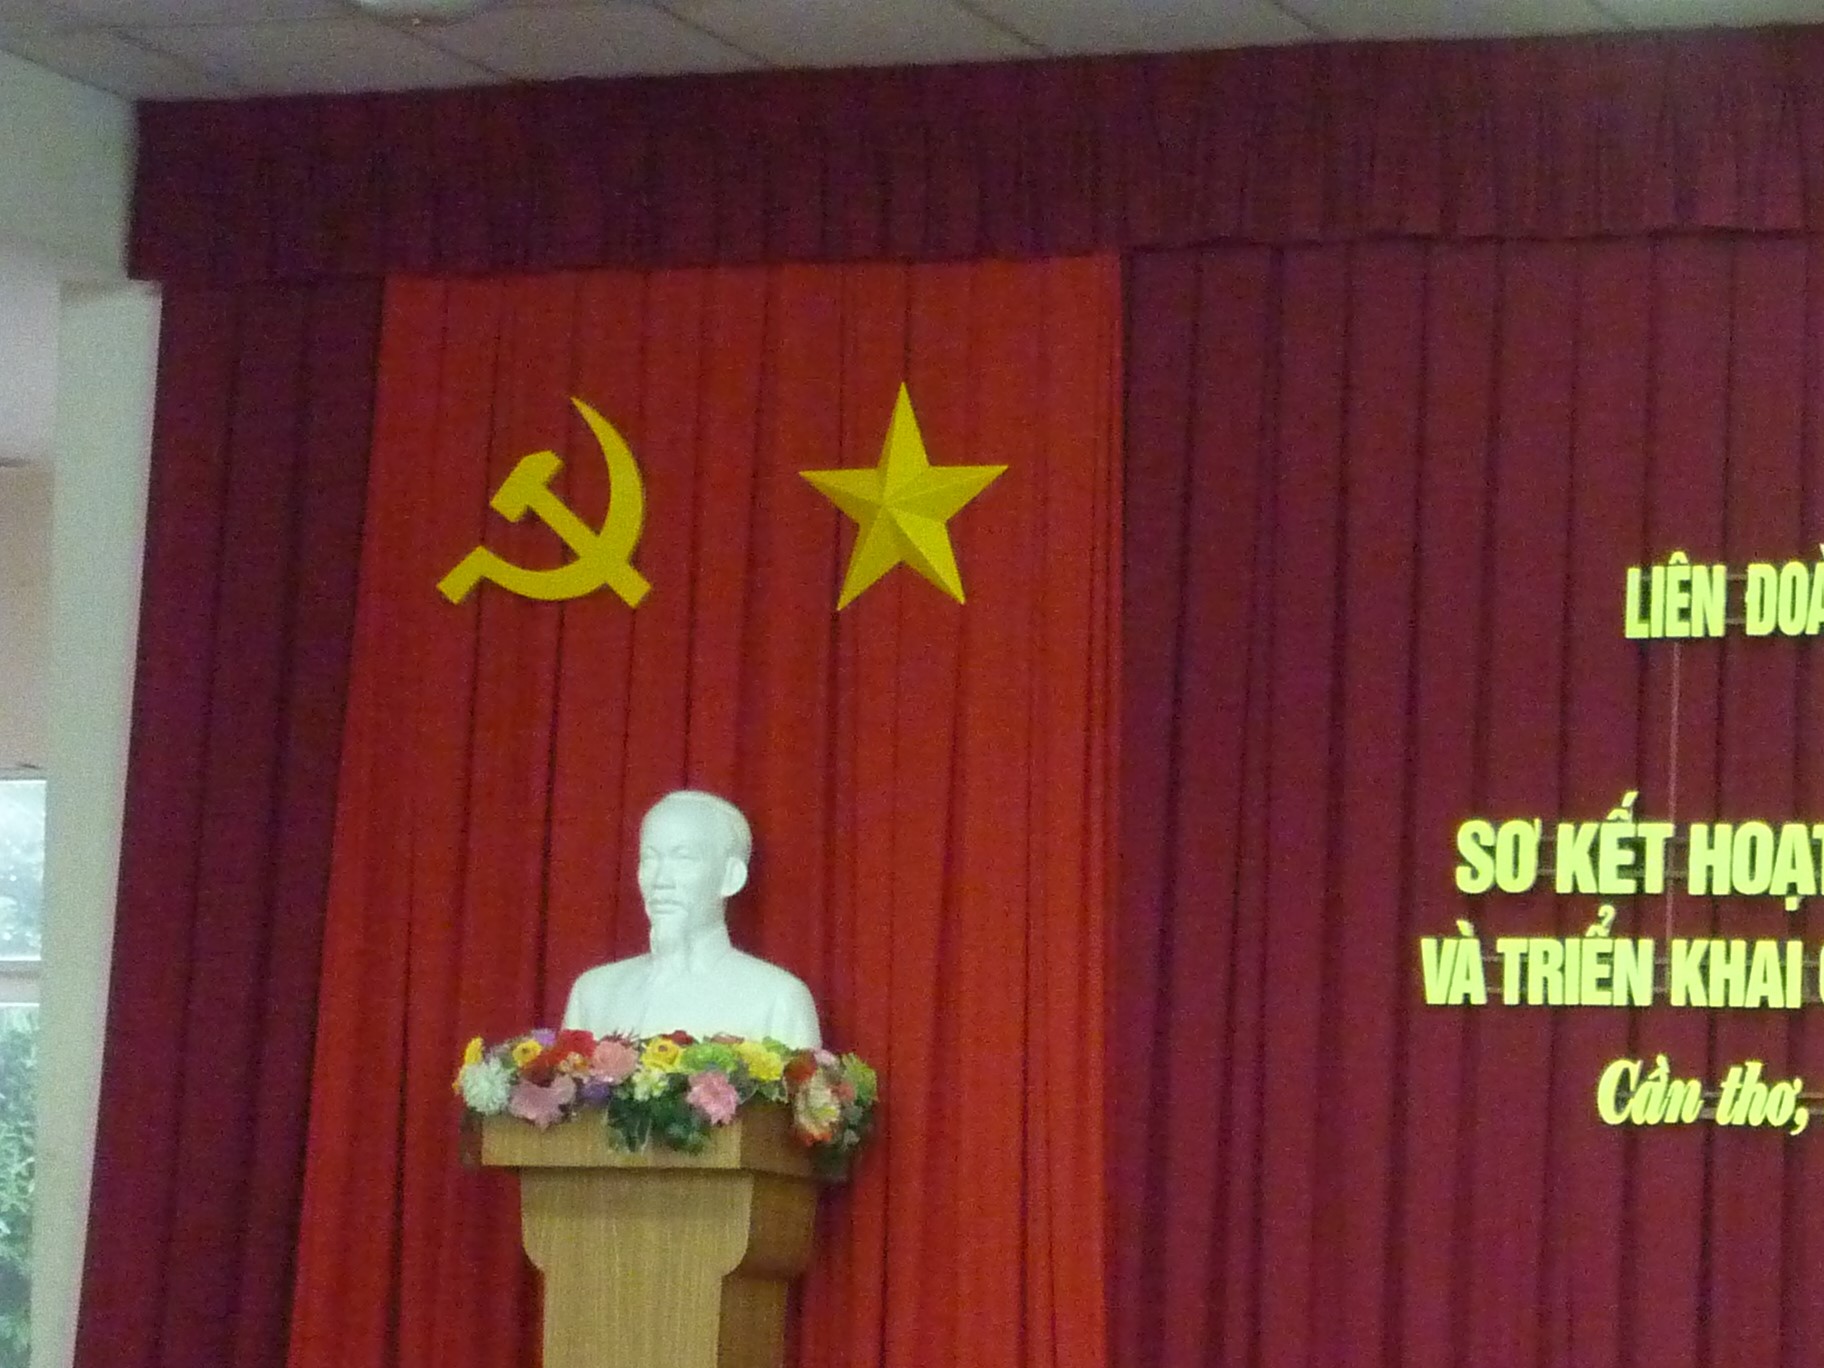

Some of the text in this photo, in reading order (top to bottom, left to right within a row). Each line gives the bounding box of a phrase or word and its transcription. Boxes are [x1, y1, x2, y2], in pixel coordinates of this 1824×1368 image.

[1624, 550, 1729, 639] LIÊN
[1454, 817, 1543, 895] SƠ
[1552, 790, 1677, 895] KẾT
[1419, 918, 1488, 1006] VÀ
[1495, 903, 1659, 1007] TRIỂN
[1667, 937, 1807, 1009] KHAI
